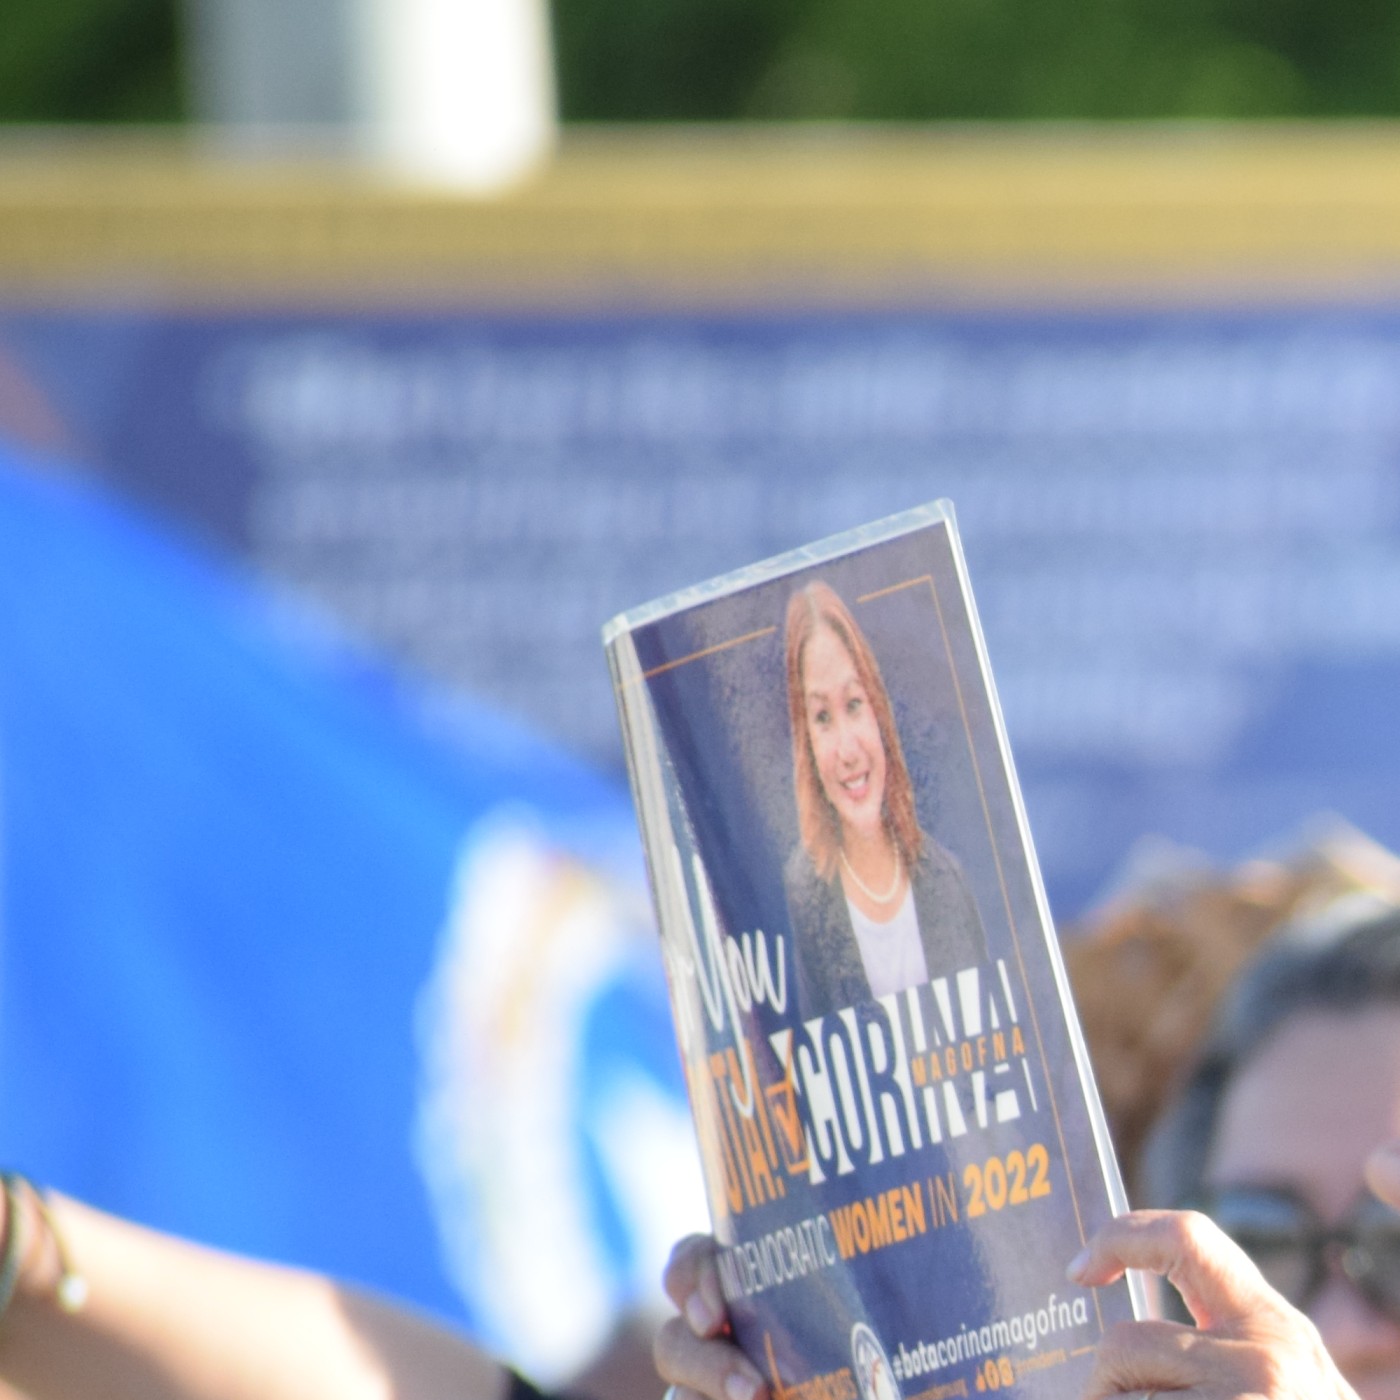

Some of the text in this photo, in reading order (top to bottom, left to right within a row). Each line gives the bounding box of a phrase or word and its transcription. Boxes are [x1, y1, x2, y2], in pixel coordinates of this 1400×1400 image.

[780, 958, 1038, 1185] CORINA
[911, 1026, 1026, 1087] MAGOFNA
[732, 1213, 837, 1296] DEMOCRATIC
[829, 1181, 927, 1261] WOMEN
[927, 1172, 960, 1229] IN
[963, 1143, 1053, 1218] 2022
[892, 1294, 1089, 1381] #botacorinamagofna
